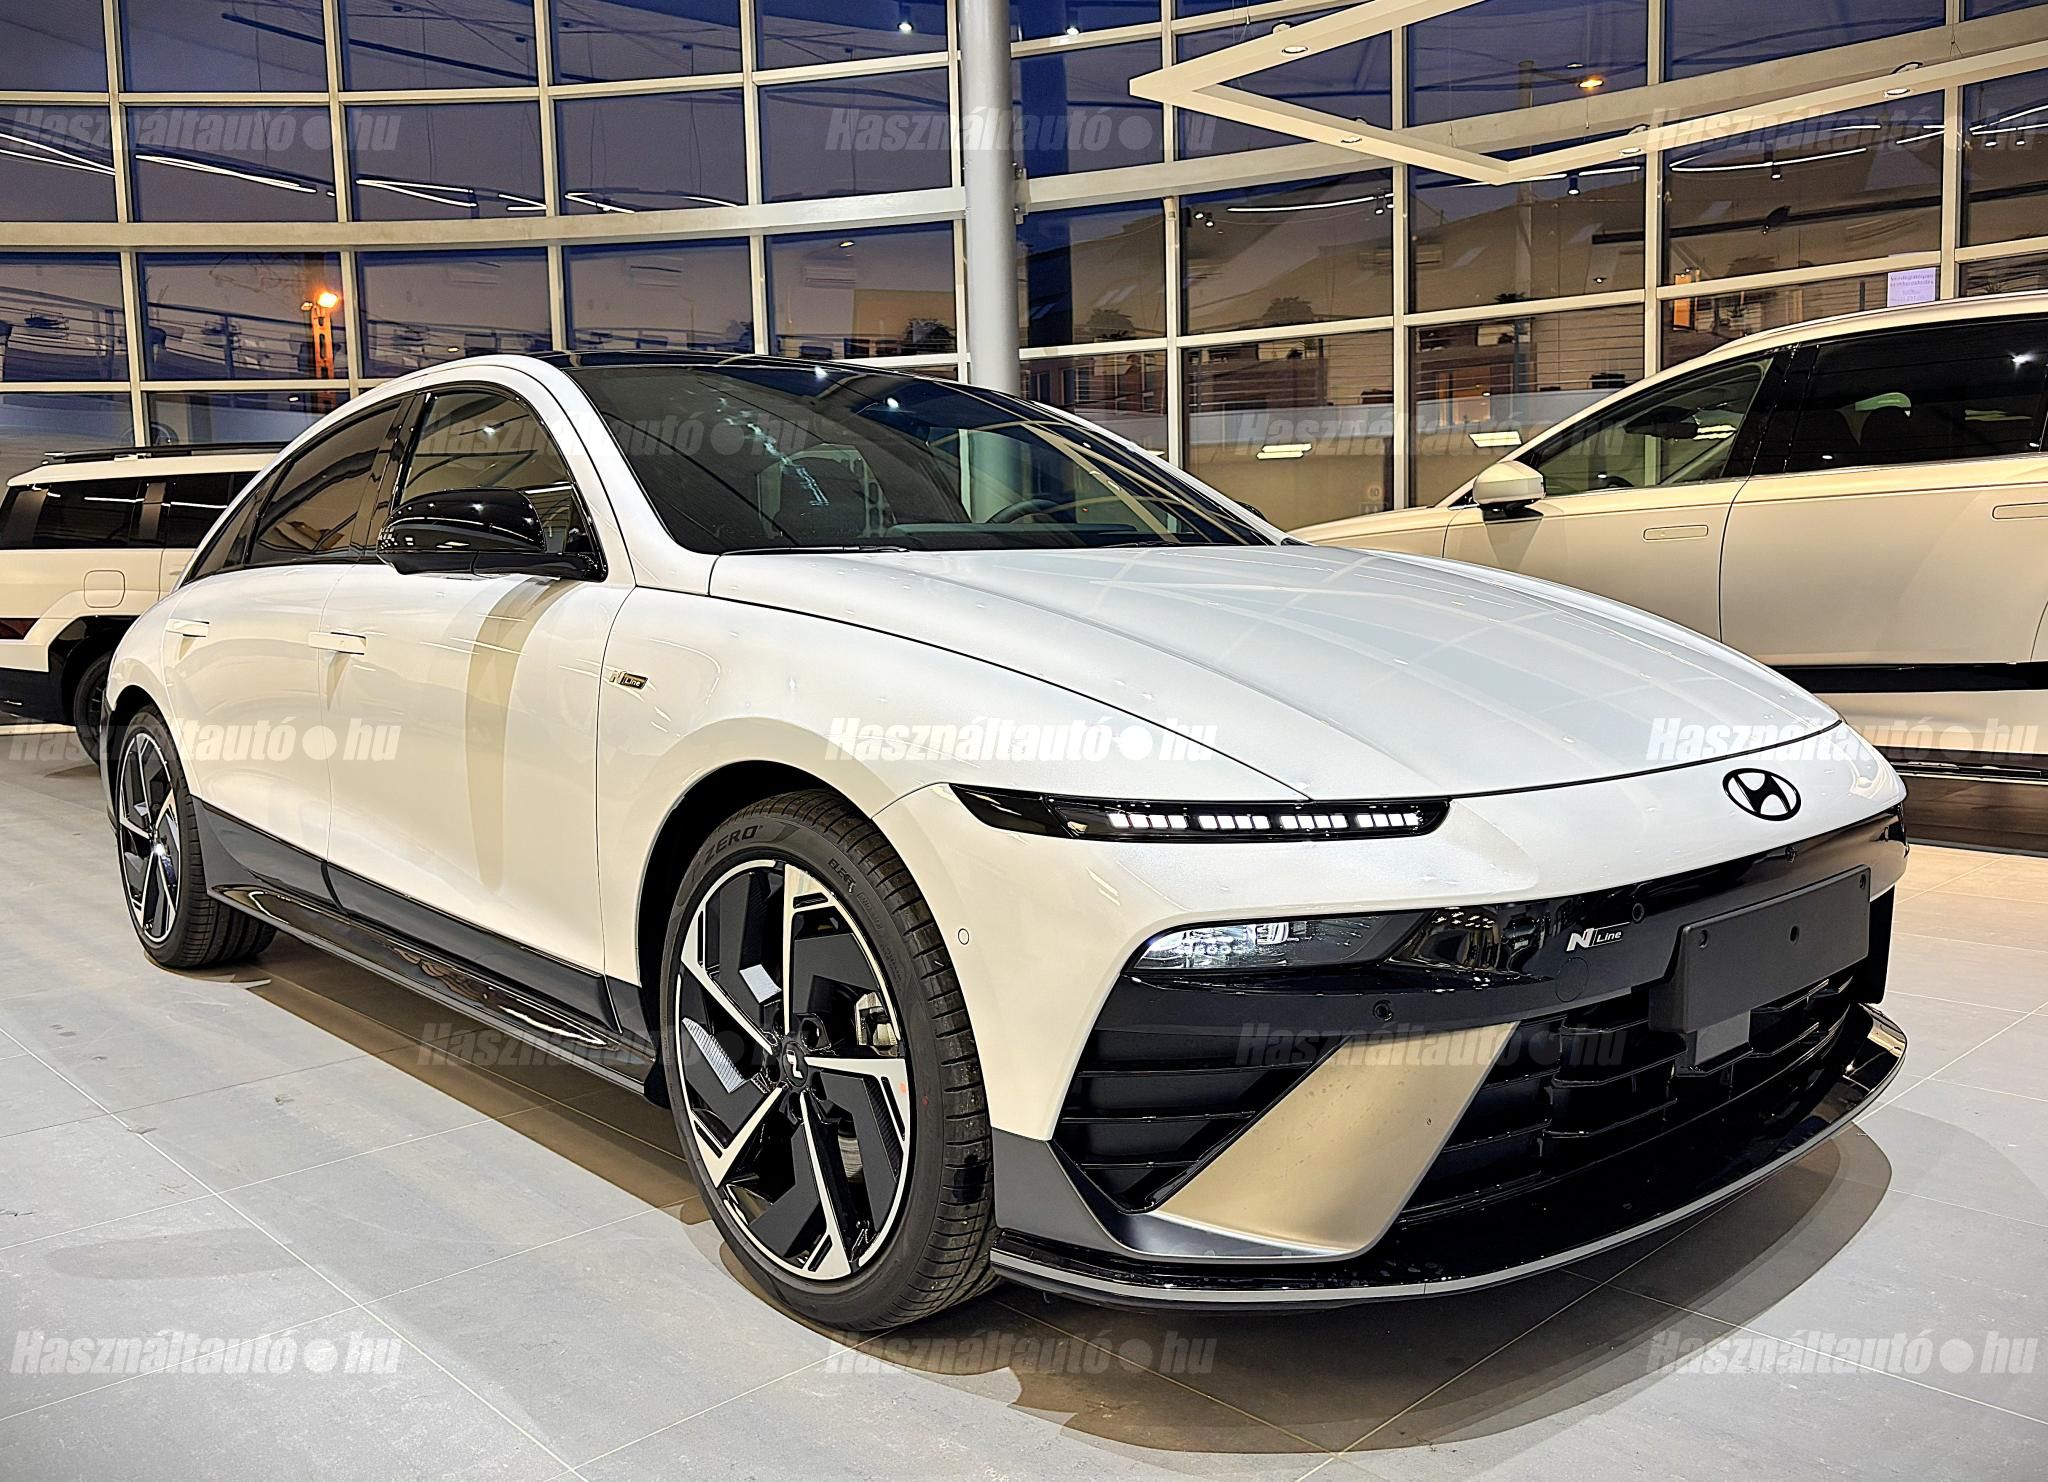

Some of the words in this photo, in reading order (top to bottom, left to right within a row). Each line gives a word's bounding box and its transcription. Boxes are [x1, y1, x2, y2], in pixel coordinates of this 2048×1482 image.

[704, 825, 758, 865] ZERO
[1566, 927, 1595, 951] N
[1596, 931, 1622, 942] Line
